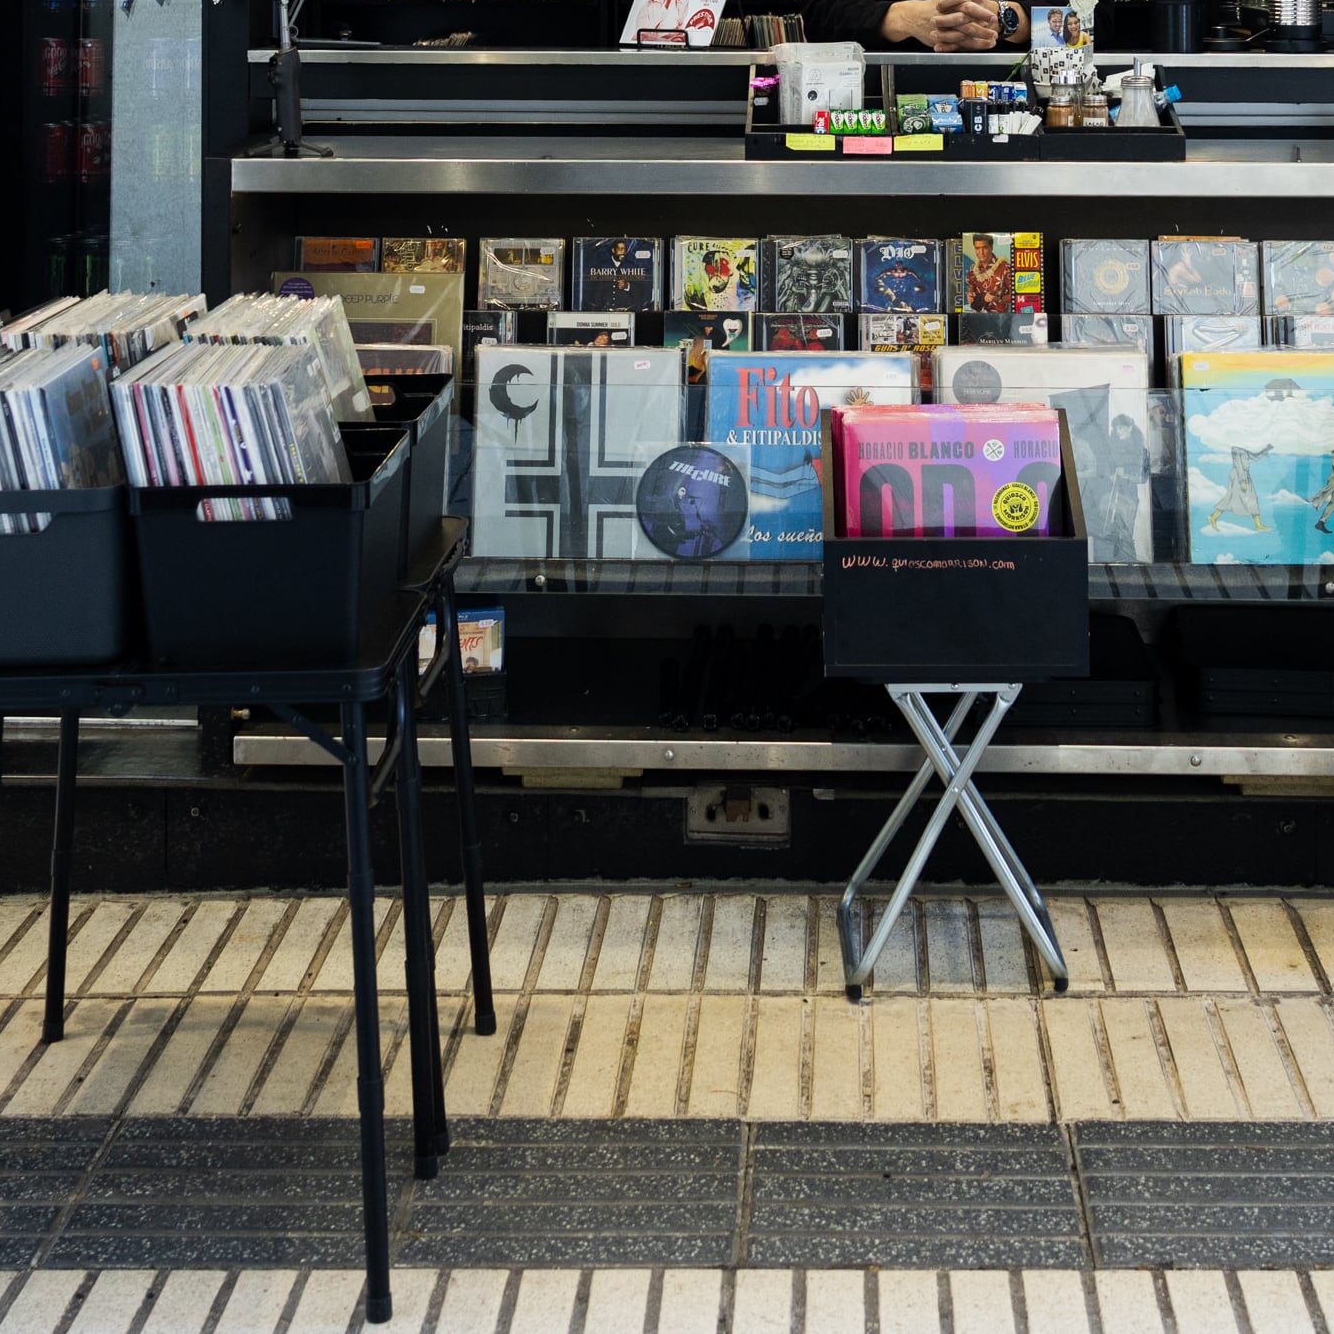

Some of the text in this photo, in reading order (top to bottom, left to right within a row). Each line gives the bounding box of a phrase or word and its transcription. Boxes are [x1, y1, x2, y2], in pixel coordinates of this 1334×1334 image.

[687, 242, 710, 253] CURE
[1016, 251, 1039, 269] ELVIS
[589, 267, 646, 276] BARRY WHITE
[874, 343, 898, 353] GUNS
[735, 366, 820, 429] Fito
[726, 430, 738, 445] &
[858, 441, 904, 460] HORACIO
[908, 441, 975, 460] BLANCO
[744, 522, 770, 544] Los
